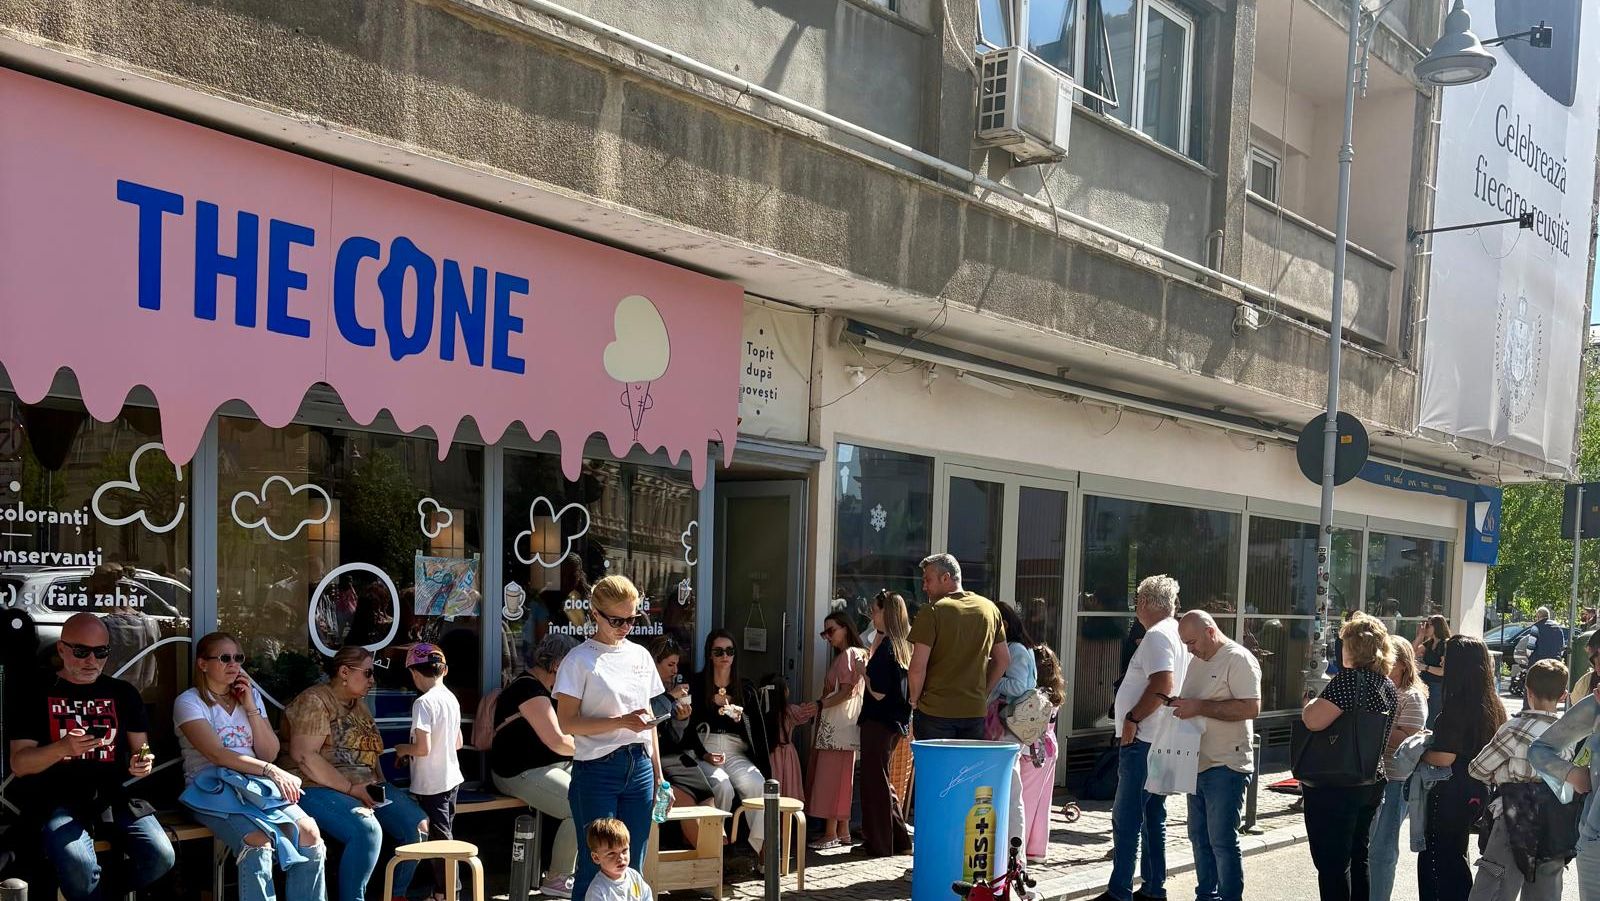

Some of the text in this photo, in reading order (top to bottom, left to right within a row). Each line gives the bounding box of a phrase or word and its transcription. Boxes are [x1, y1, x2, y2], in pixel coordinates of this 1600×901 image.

[1495, 104, 1567, 194] Celebrează
[1474, 154, 1527, 219] fiecare
[117, 179, 530, 375] THE CONE
[746, 341, 775, 363] Topit
[746, 362, 772, 383] după
[48, 585, 88, 606] fără
[95, 587, 147, 608] zahăr
